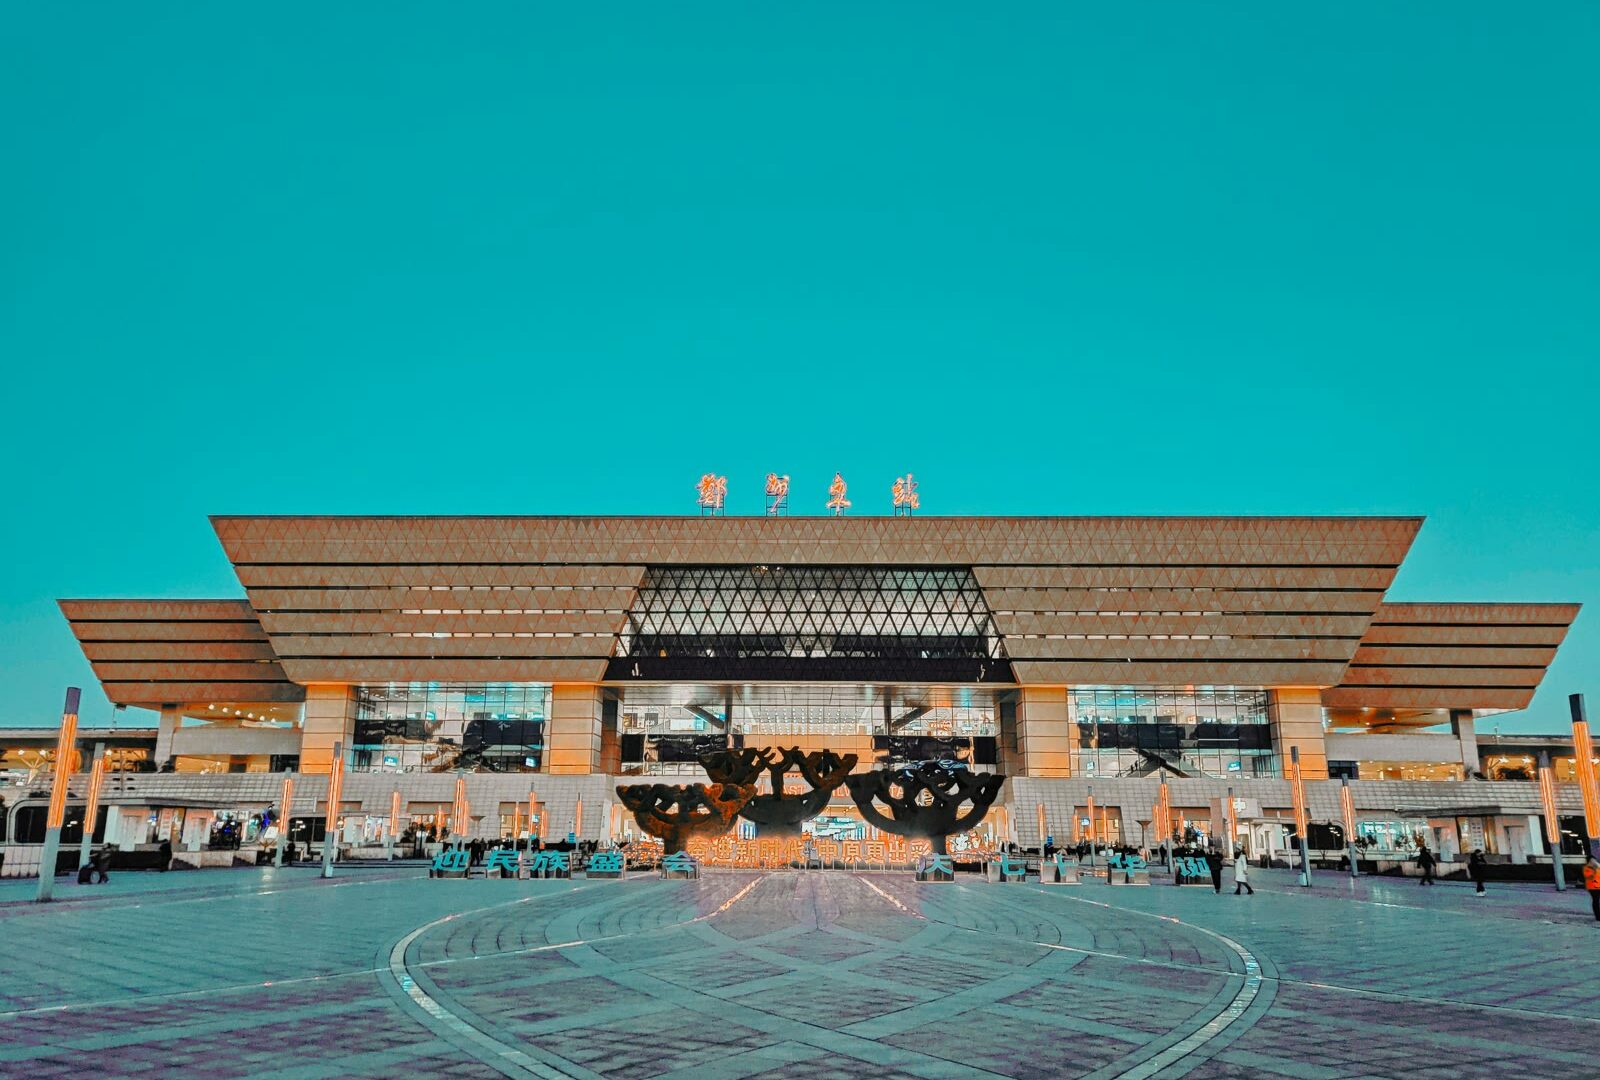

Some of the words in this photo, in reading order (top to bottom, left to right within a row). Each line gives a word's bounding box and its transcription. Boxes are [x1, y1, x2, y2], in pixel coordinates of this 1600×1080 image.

[432, 849, 694, 872] 迎民族盛会
[819, 839, 932, 864] 中原更出彩
